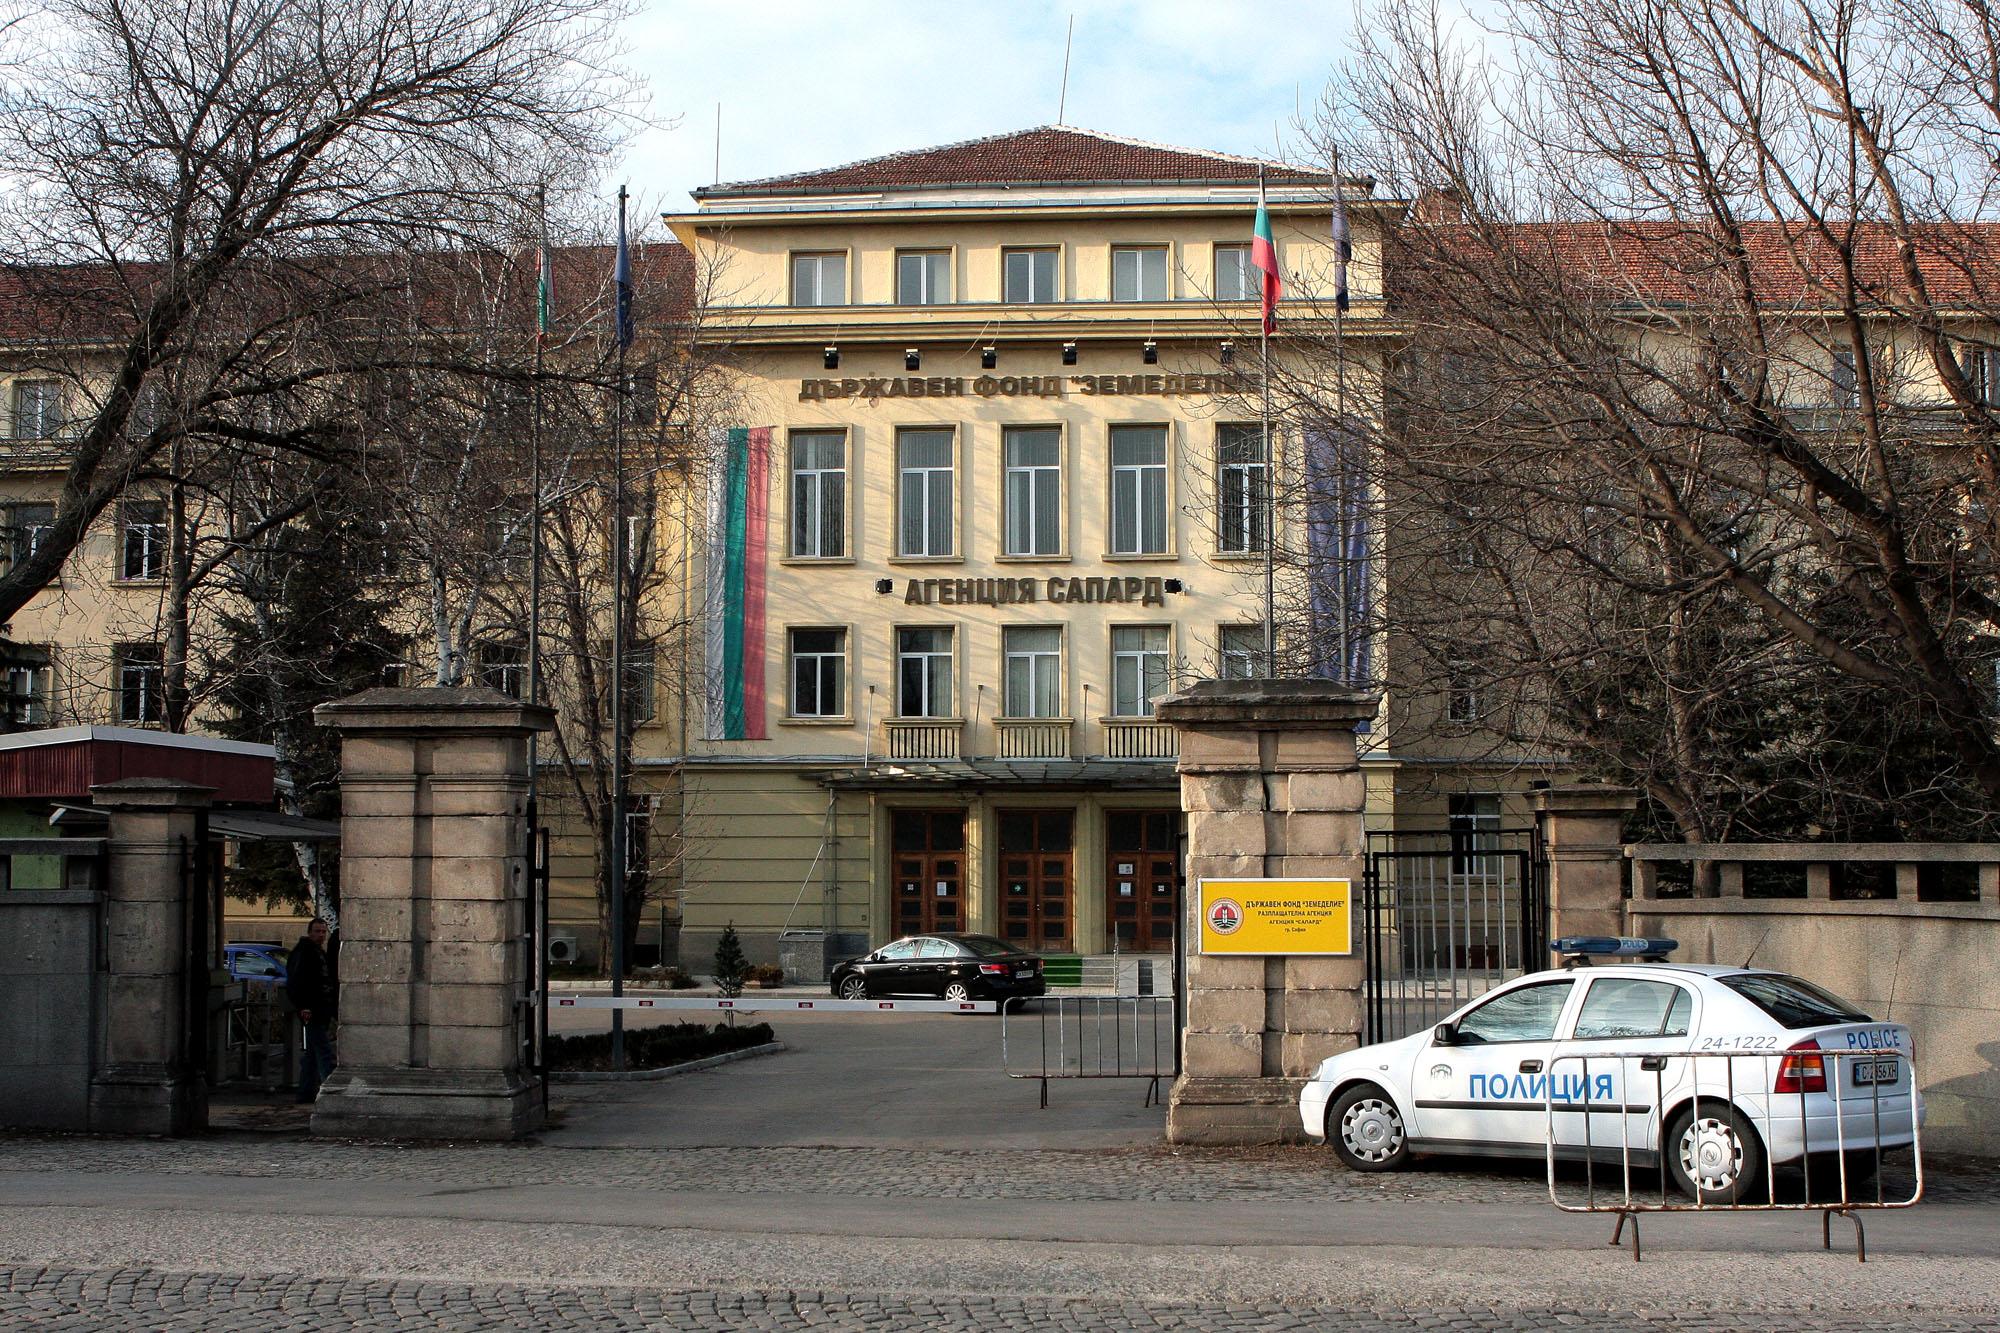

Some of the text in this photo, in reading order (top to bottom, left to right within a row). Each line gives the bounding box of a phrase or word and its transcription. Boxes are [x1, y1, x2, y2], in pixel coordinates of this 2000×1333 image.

[799, 377, 964, 399] ДЪРЖАВЕН
[973, 375, 1062, 399] ФОНД
[904, 576, 1164, 607] АГЕНЦИЯ САПАРД
[1245, 900, 1281, 908] ДЪРЖАВЕН
[1282, 900, 1302, 908] ФОНД
[1701, 1036, 1778, 1050] 24-1222
[1846, 1029, 1900, 1049] POLICE
[1469, 1074, 1612, 1104] ПОЛИЦИЯ
